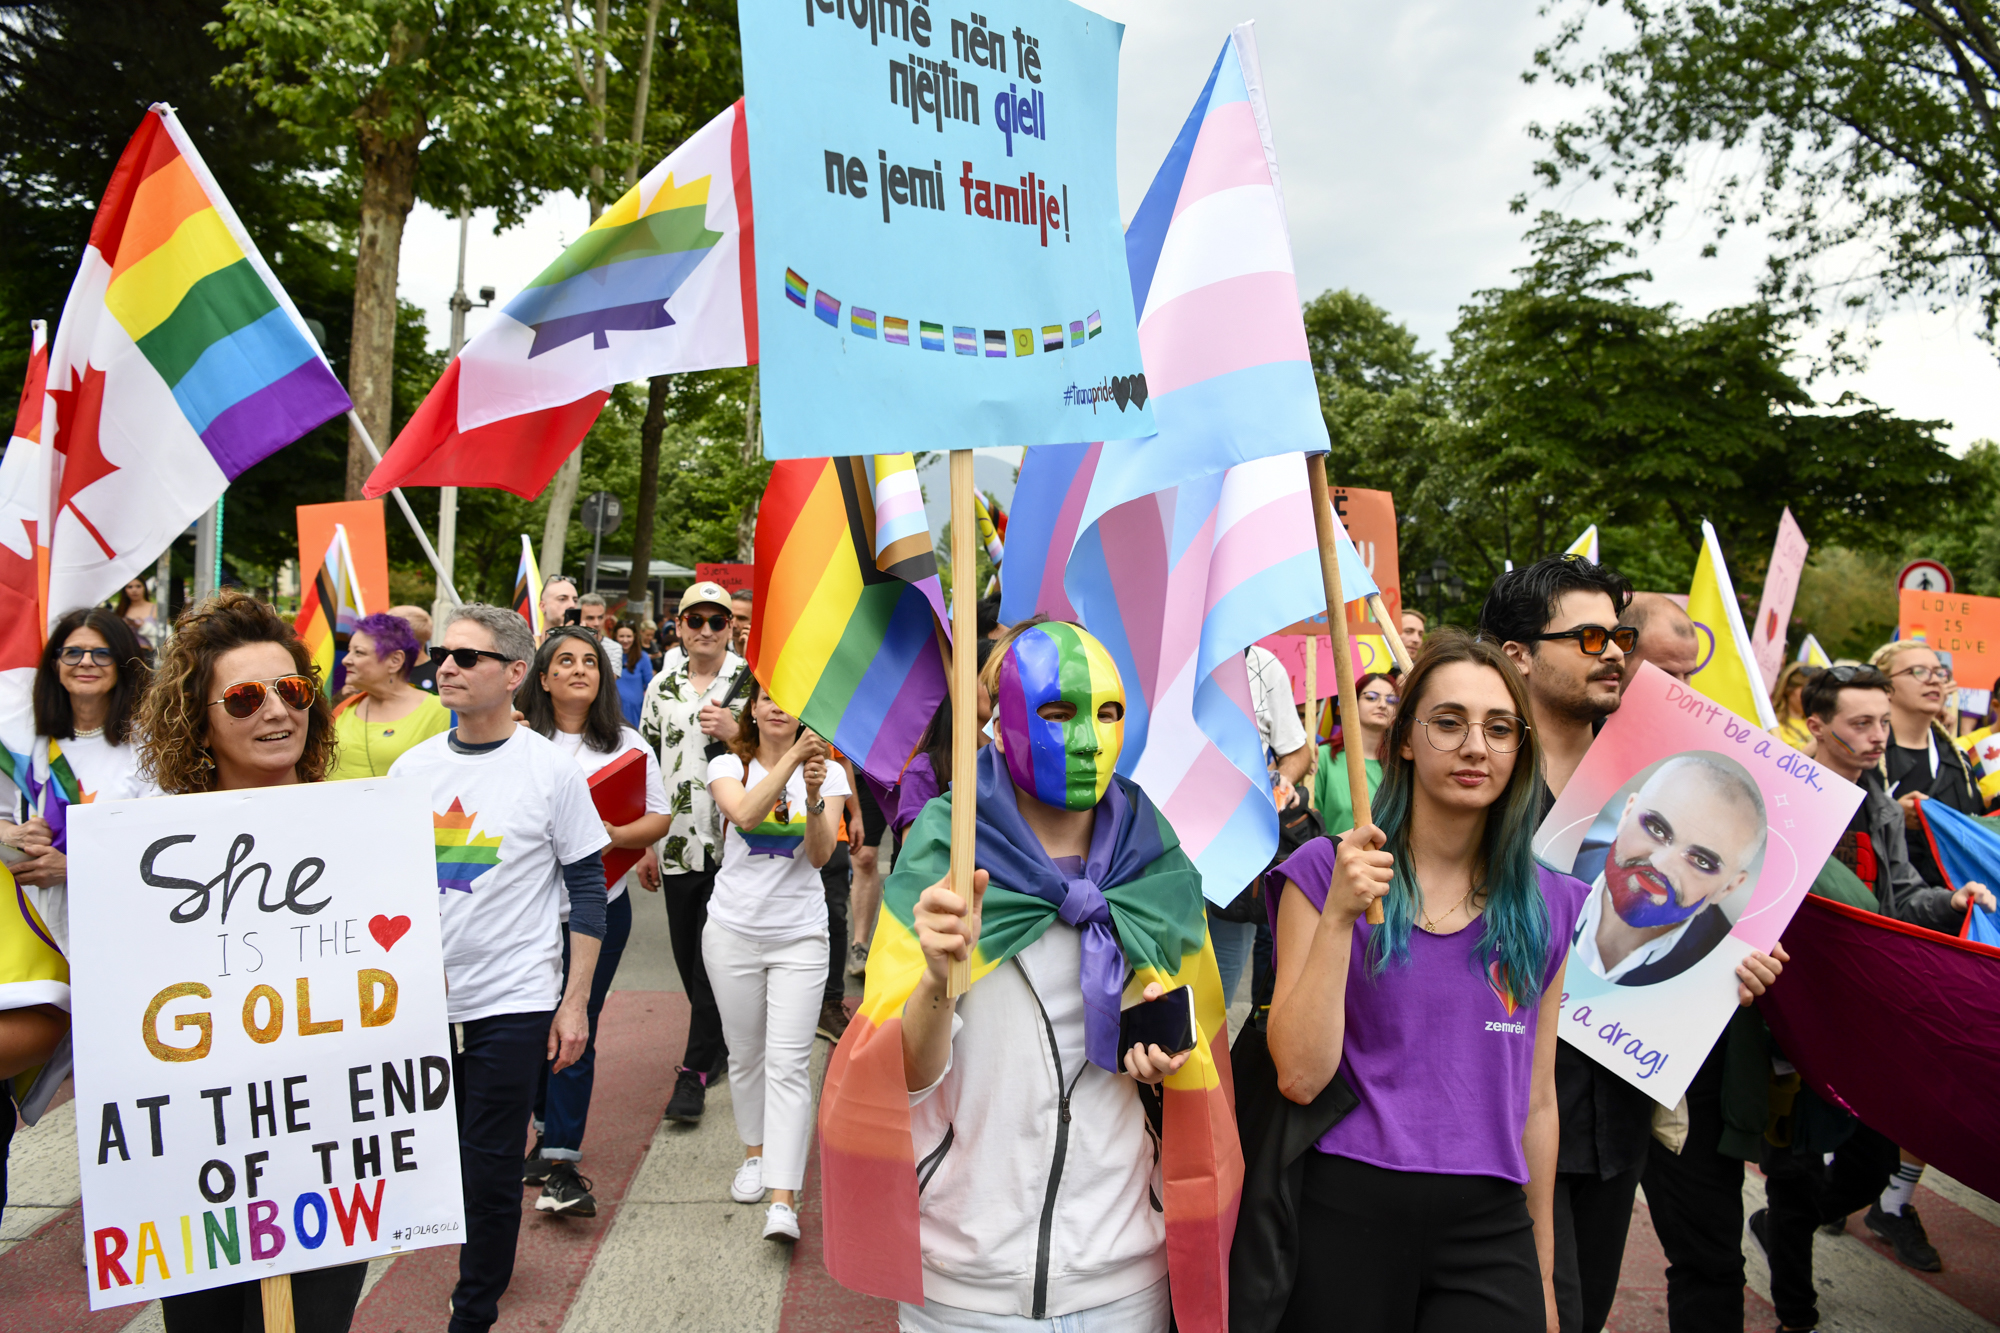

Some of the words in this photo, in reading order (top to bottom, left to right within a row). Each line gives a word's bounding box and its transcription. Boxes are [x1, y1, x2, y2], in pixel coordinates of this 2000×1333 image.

[951, 12, 1007, 73] nën
[1012, 26, 1042, 84] të
[889, 53, 980, 132] njëjtin
[995, 83, 1046, 157] qiell
[824, 149, 868, 199] ne
[878, 149, 945, 223] jemi
[959, 161, 1070, 247] familje!
[1922, 599, 1970, 615] LOVE
[1944, 619, 1963, 633] IS
[1938, 638, 1986, 654] LOVE
[1664, 683, 1724, 728] Don't
[1724, 716, 1748, 744] be
[1754, 740, 1771, 758] a
[1777, 753, 1824, 793] dick,
[140, 833, 332, 924] She
[217, 931, 263, 977] IS
[291, 918, 361, 963] THE
[142, 968, 399, 1063] GOLD
[1573, 1004, 1593, 1027] a
[1598, 1021, 1669, 1079] drag!
[98, 1094, 171, 1165] AT
[200, 1074, 311, 1146] THE
[348, 1055, 451, 1123] END
[199, 1150, 270, 1203] OF
[312, 1128, 418, 1184] THE
[93, 1178, 386, 1291] RAINBOW
[392, 1221, 460, 1241] #JOLAGOLD
